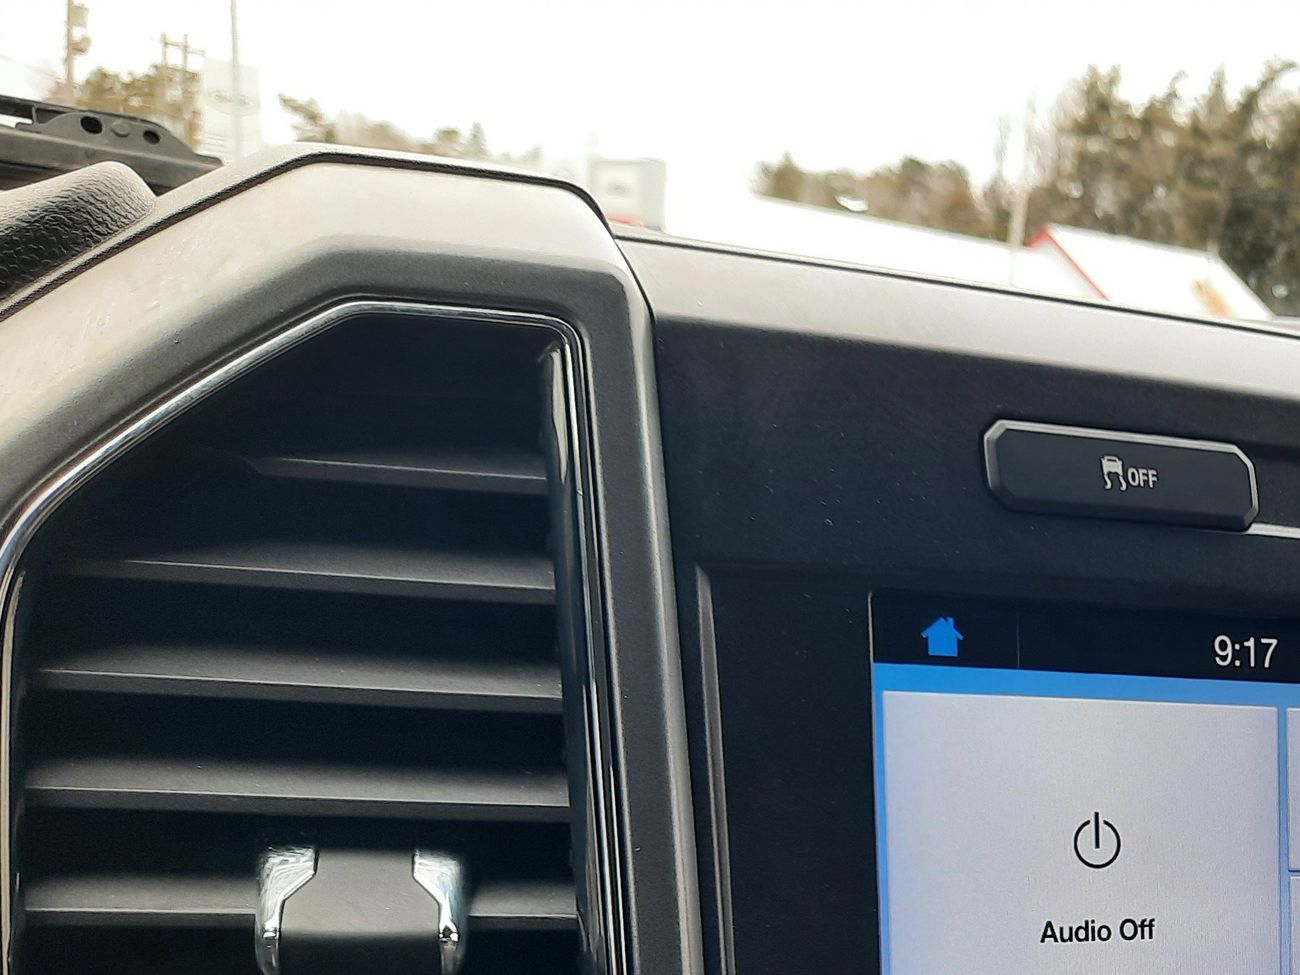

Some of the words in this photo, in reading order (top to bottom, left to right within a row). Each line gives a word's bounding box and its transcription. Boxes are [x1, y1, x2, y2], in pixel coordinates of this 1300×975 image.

[1127, 467, 1158, 488] OFF
[1213, 634, 1278, 668] 9:17
[1039, 920, 1112, 944] Audio
[1118, 918, 1156, 942] Off
